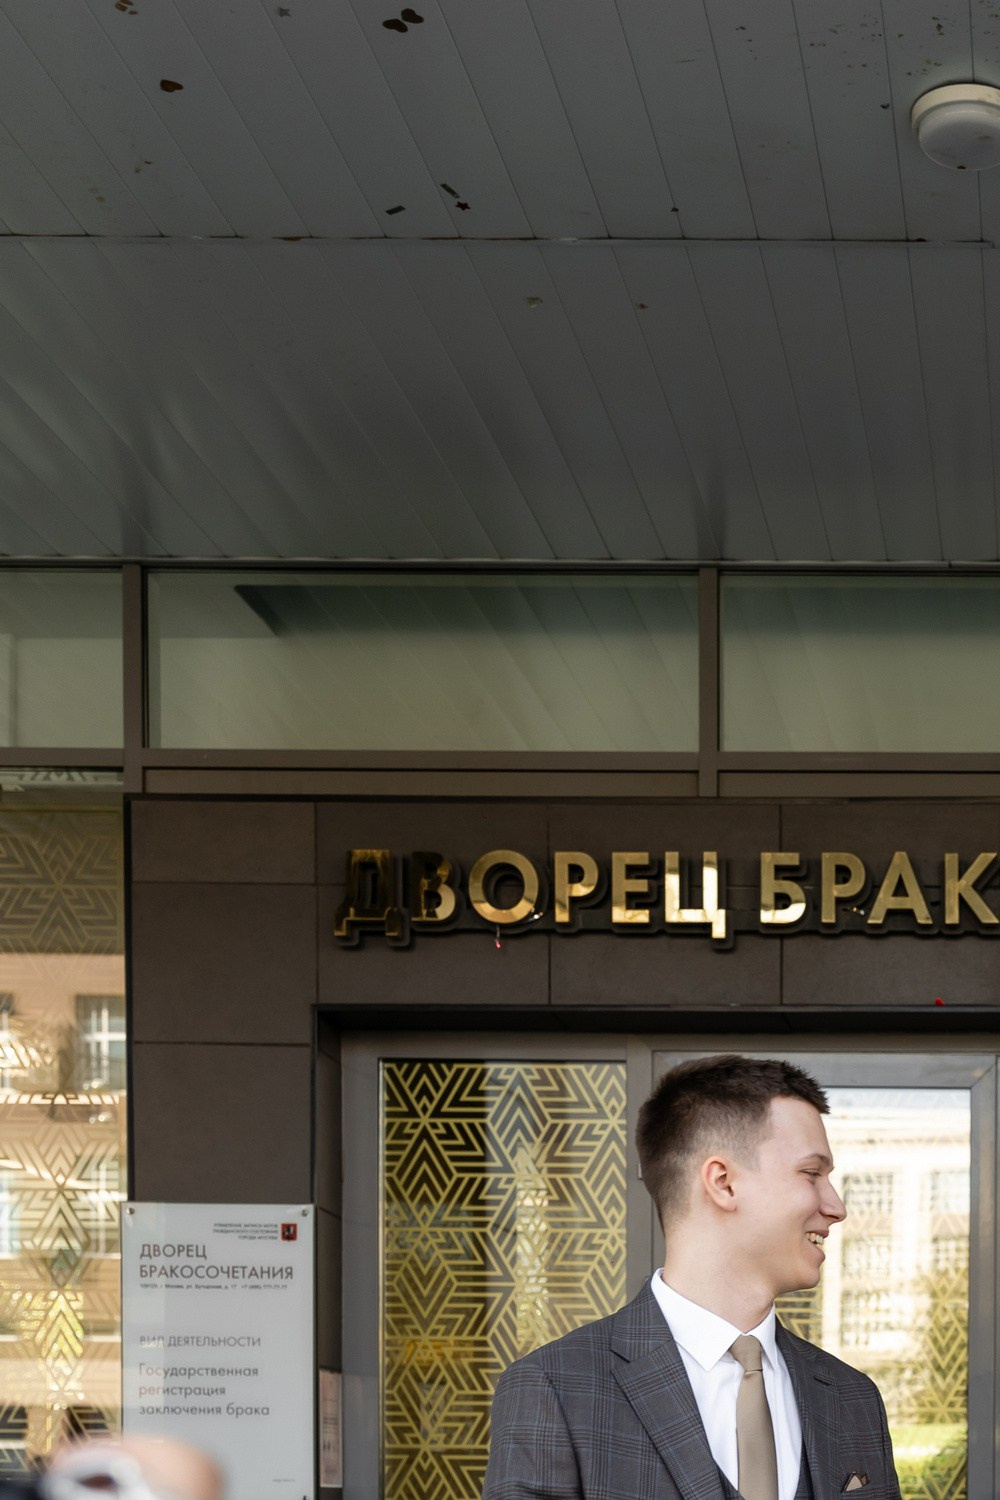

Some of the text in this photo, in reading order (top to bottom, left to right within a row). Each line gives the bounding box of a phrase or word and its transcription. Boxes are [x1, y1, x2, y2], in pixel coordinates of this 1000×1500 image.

[334, 848, 727, 939] ДВОРЕЦ
[139, 1243, 207, 1260] ДВОРЕЦ
[139, 1264, 294, 1280] БРАКОСОЧЕТАНИЯ
[139, 1335, 262, 1348] ВИД ДЕЯТЕЛЬНОСТИ
[138, 1363, 259, 1379] Государственная
[138, 1385, 227, 1399] регистрация
[138, 1402, 270, 1419] заключения брака
